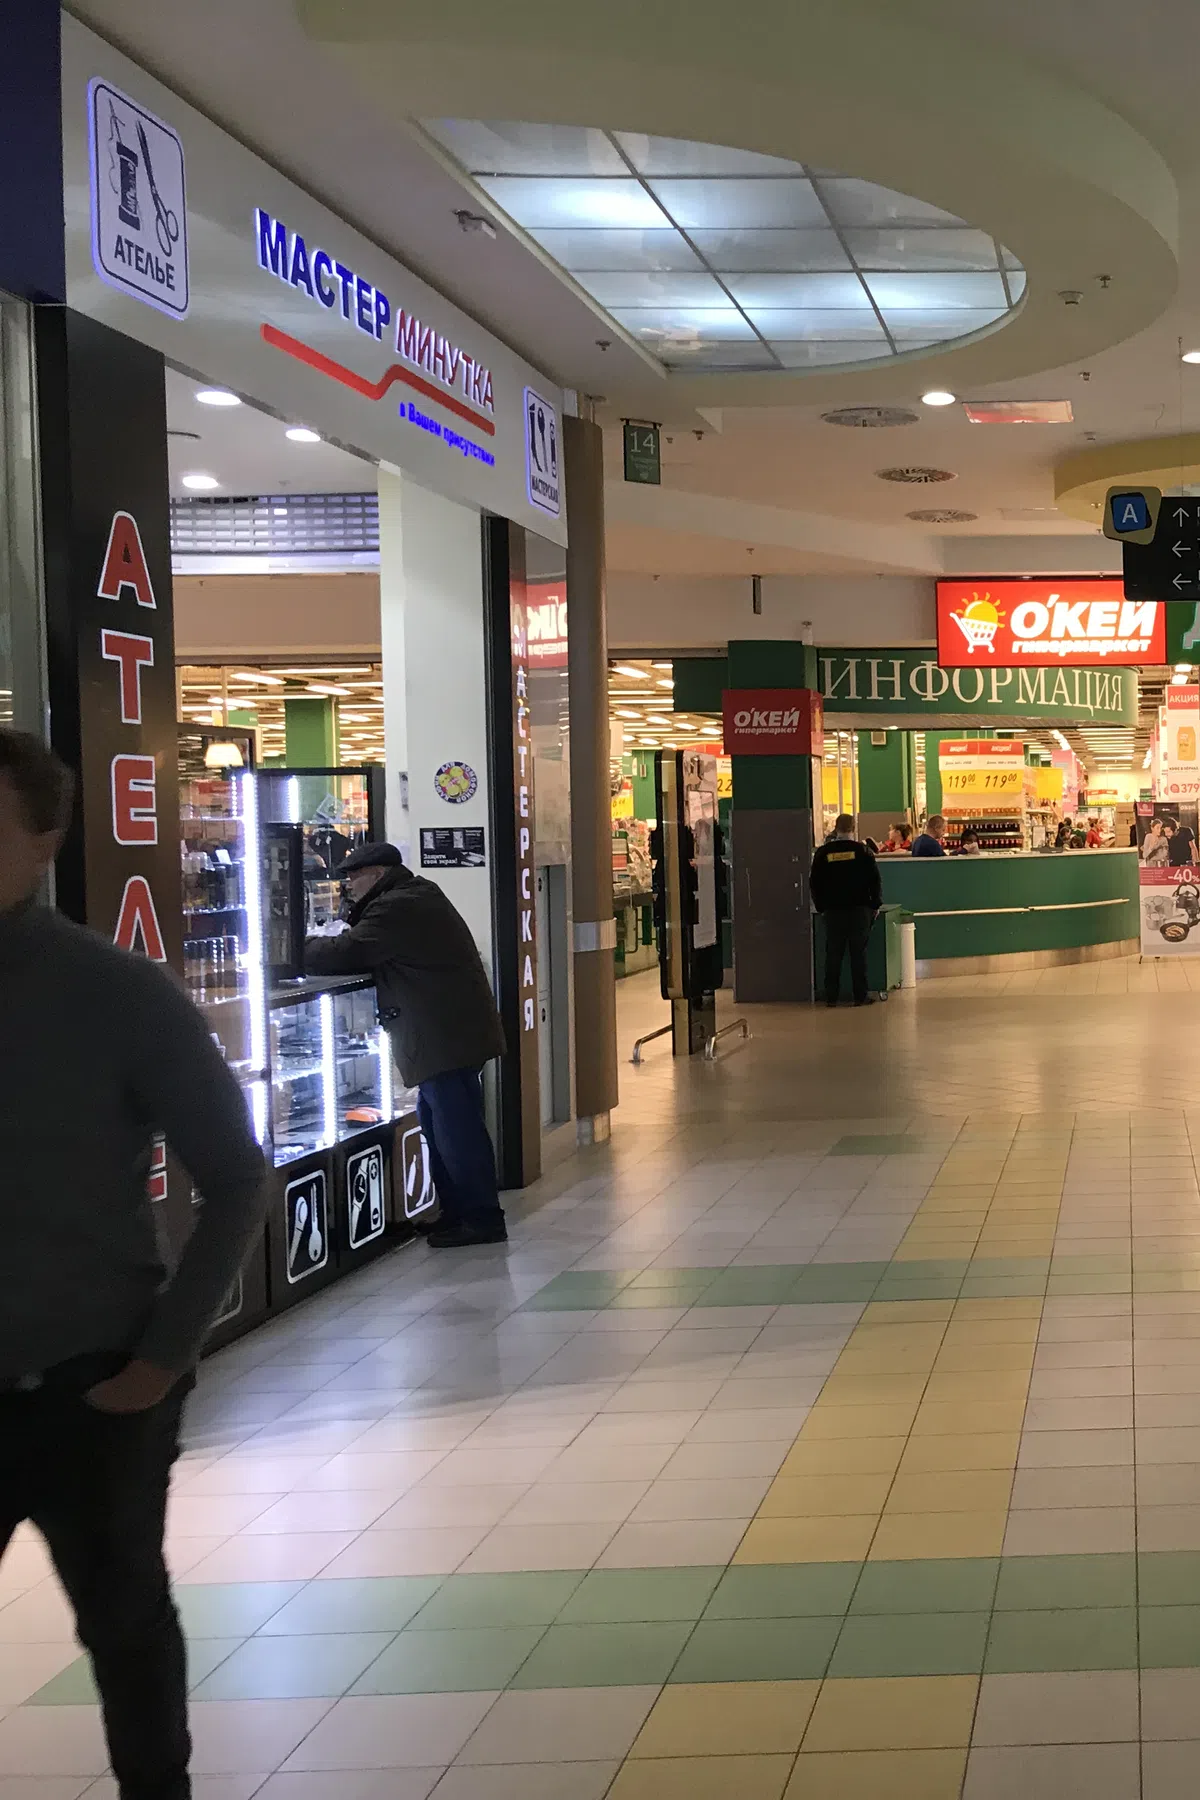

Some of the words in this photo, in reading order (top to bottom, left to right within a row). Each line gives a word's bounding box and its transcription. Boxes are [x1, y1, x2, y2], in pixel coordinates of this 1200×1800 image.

[114, 235, 176, 291] АТЕЛЬЕ
[255, 208, 391, 342] МАСТЕР
[396, 308, 496, 416] МИНУТКА
[400, 402, 405, 418] в
[408, 403, 441, 437] Вашем
[444, 427, 496, 467] присутствии
[630, 431, 656, 454] 14
[1010, 593, 1158, 639] О'КЕЙ
[1011, 638, 1152, 657] гипермаркет
[819, 657, 1123, 717] ИНФОРМАЦИЯ
[1169, 693, 1199, 703] АКЦИЯ
[733, 706, 801, 727] О'КЕЙ
[733, 727, 798, 736] гипермаркет
[512, 626, 536, 1032] МАСТЕРСКАЯ
